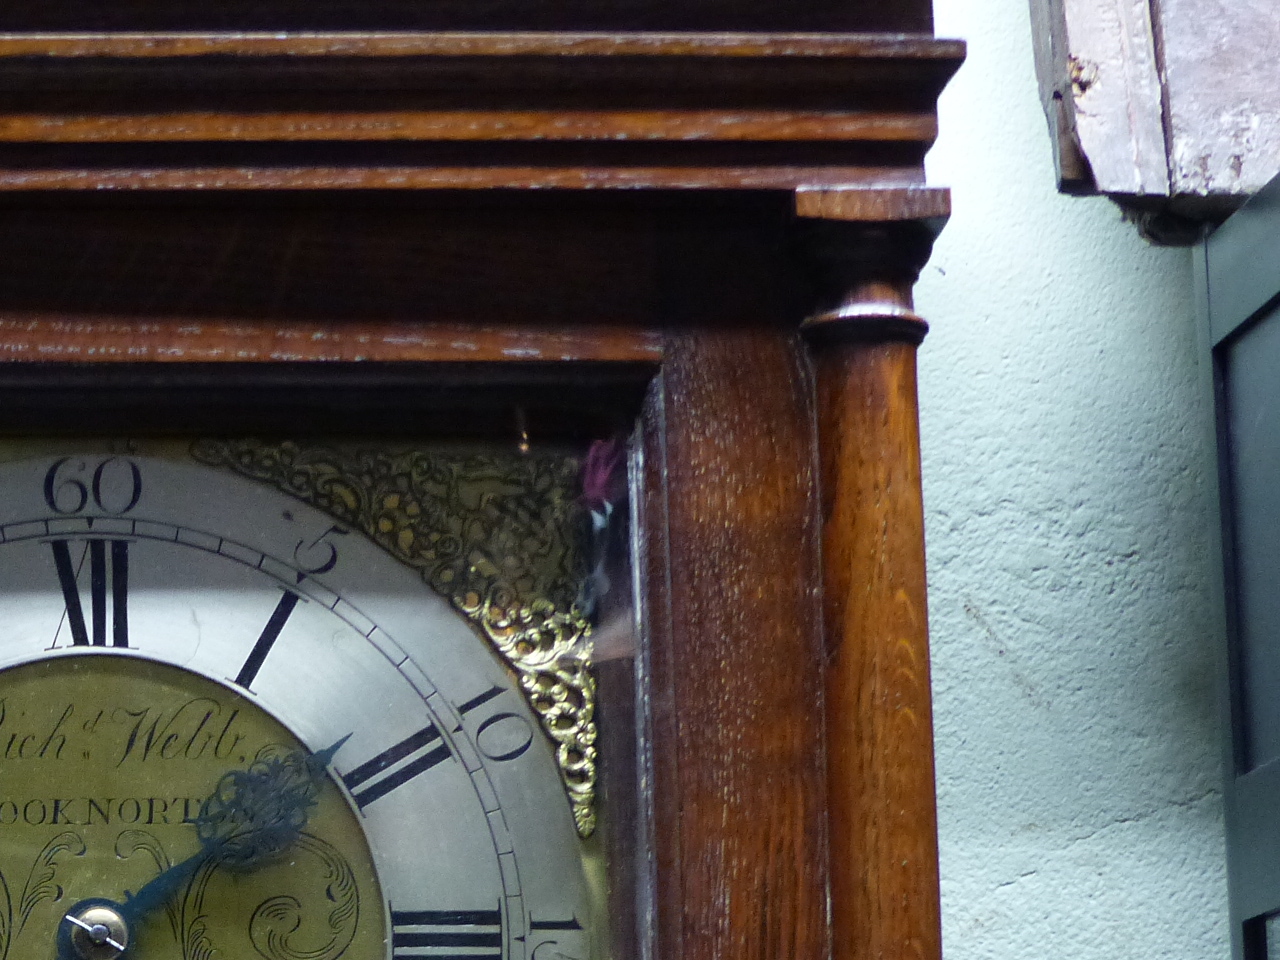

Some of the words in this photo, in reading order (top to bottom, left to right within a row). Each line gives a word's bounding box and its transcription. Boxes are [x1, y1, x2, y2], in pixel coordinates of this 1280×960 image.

[42, 456, 142, 516] 60
[294, 525, 349, 574] 5
[450, 684, 535, 763] 10
